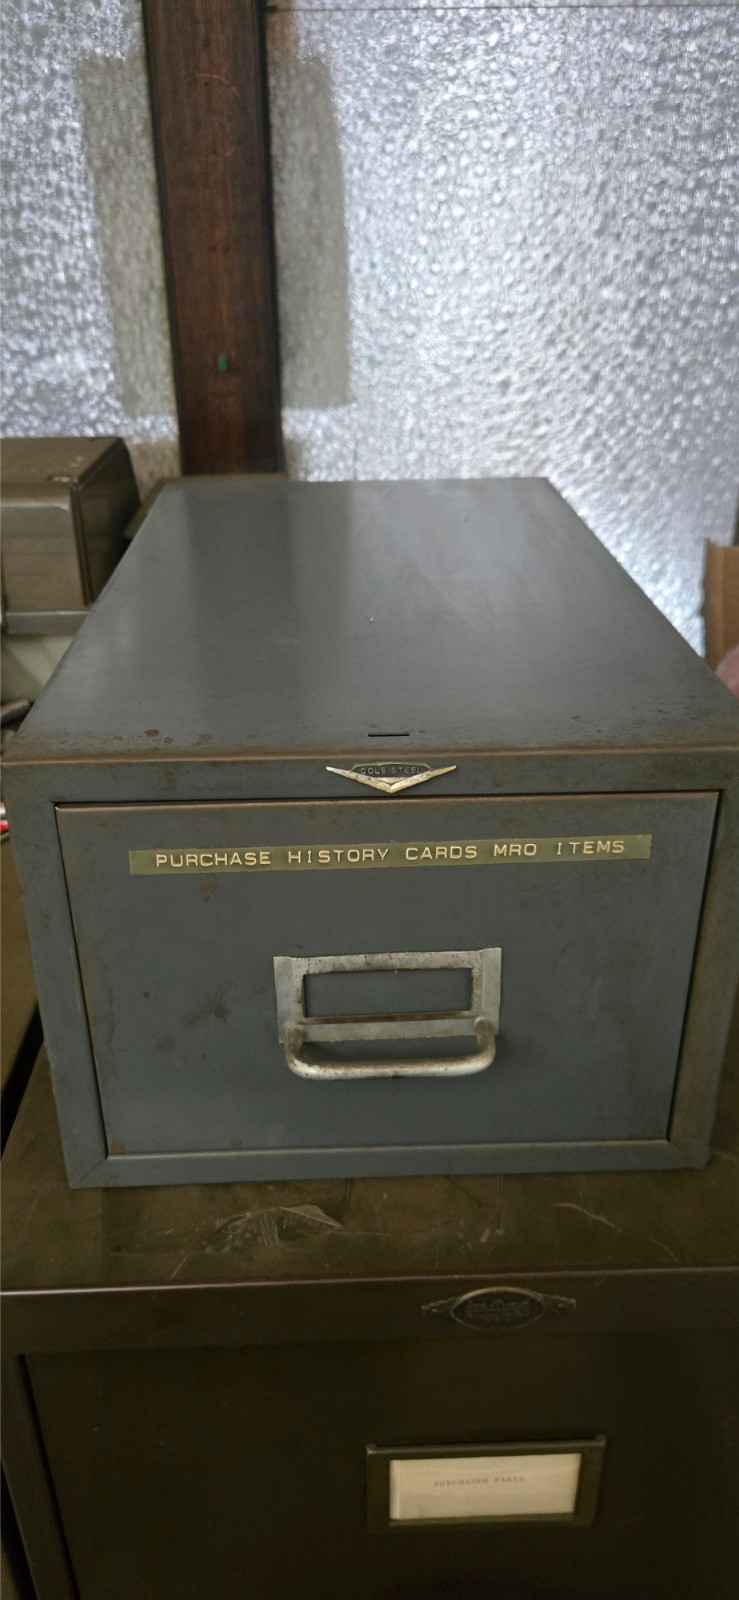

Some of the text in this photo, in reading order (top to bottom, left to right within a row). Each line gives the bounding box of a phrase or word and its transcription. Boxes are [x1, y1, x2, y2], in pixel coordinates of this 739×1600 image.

[360, 765, 421, 775] COLE STEEL
[155, 840, 625, 868] PURCHASE HISTORY CARDS MRO ITEMS
